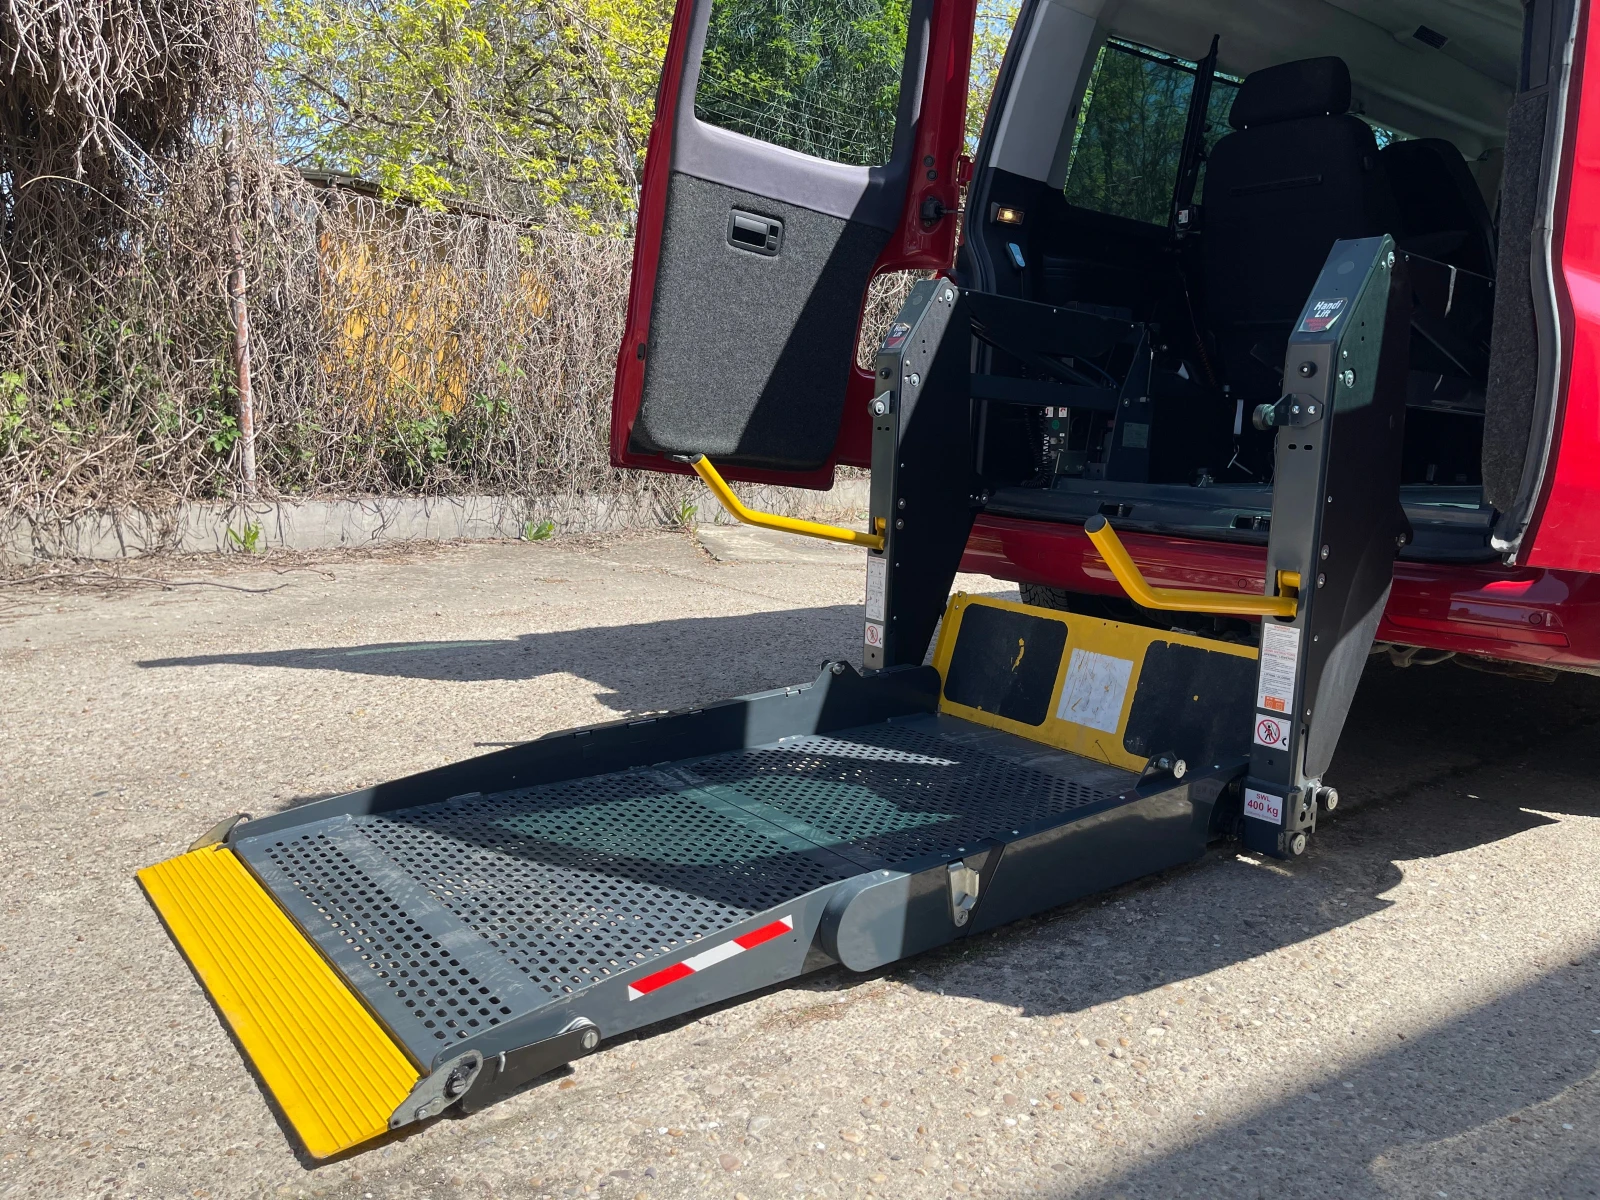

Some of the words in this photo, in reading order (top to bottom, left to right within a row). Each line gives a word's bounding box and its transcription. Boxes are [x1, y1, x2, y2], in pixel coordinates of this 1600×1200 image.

[1313, 300, 1343, 310] Handi
[1315, 310, 1331, 318] Lift
[1256, 793, 1271, 802] SWL
[1247, 799, 1264, 811] 400
[1267, 804, 1279, 818] kg
